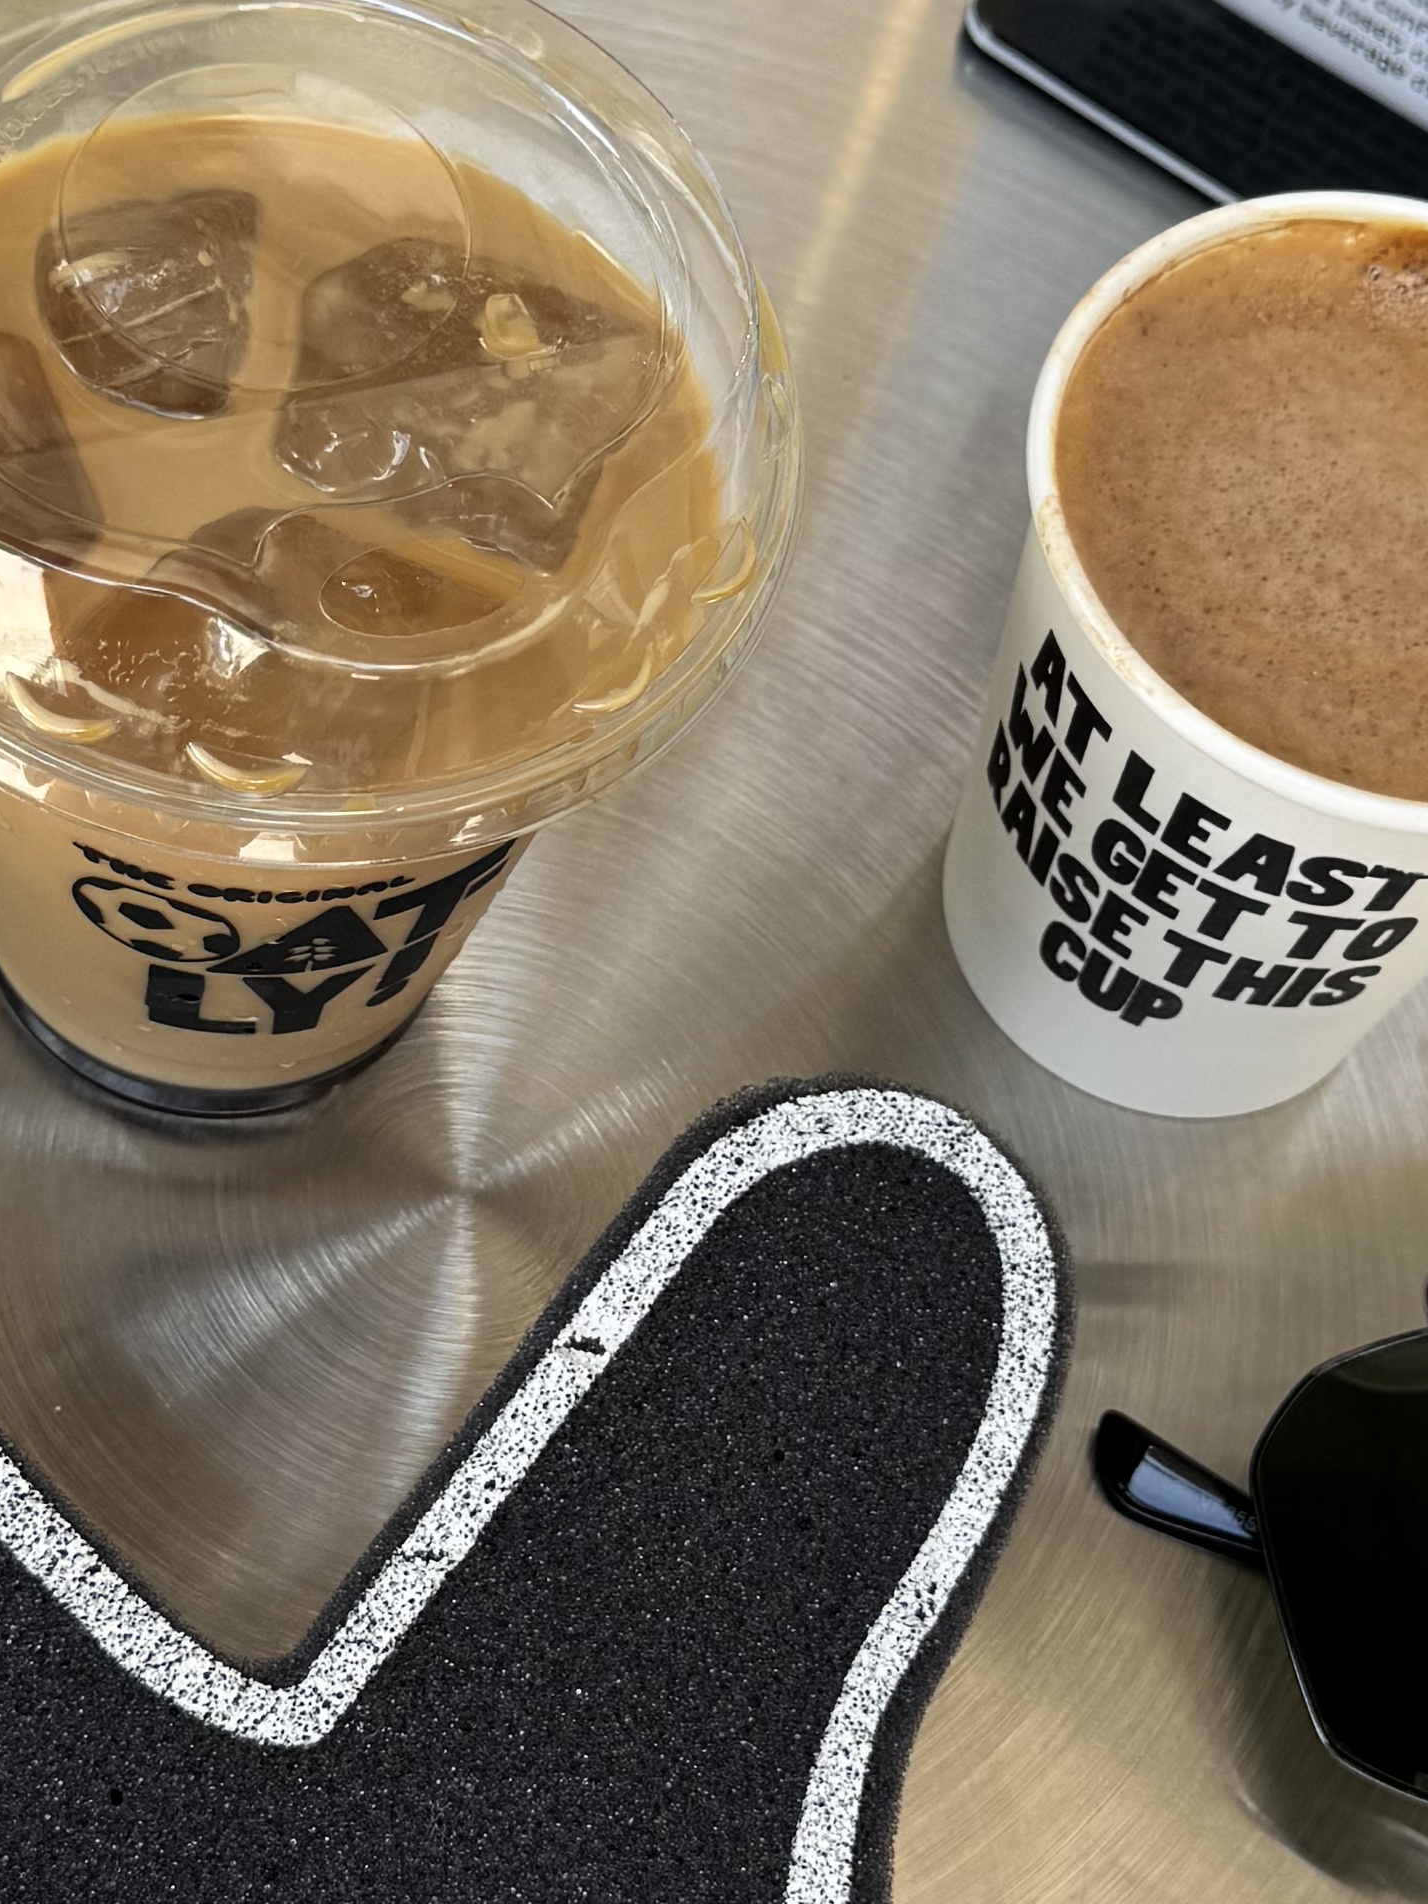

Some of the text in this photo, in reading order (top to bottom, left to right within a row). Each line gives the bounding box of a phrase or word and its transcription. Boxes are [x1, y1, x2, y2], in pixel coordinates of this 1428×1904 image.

[1031, 629, 1112, 765] AT
[73, 841, 415, 904] THE ORIGINAL
[987, 719, 1381, 1007] RAISE THIS
[1009, 661, 1419, 961] WE GET TO
[1039, 921, 1183, 1026] CUP
